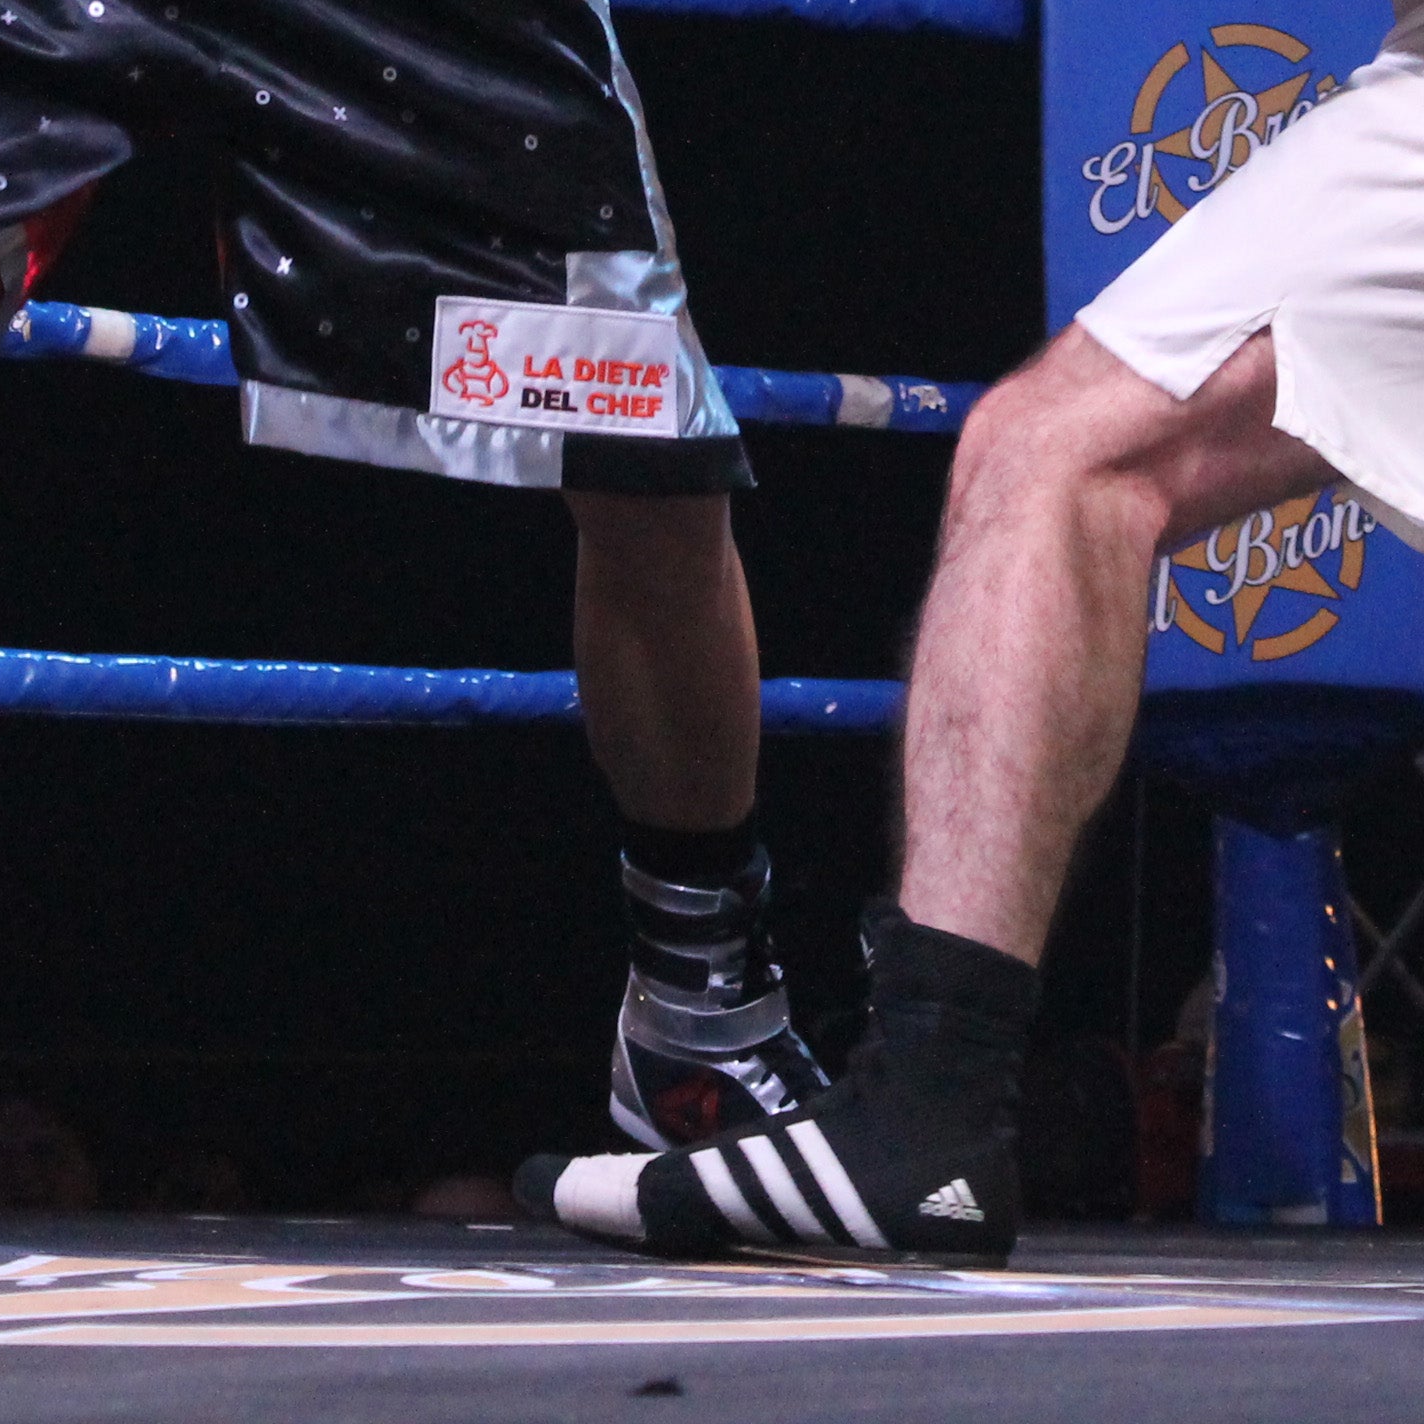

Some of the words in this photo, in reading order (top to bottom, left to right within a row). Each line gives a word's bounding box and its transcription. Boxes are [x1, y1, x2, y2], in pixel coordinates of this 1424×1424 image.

[1082, 140, 1158, 235] El
[524, 355, 563, 379] LA
[521, 388, 578, 412] DEL
[587, 393, 662, 418] CHEF
